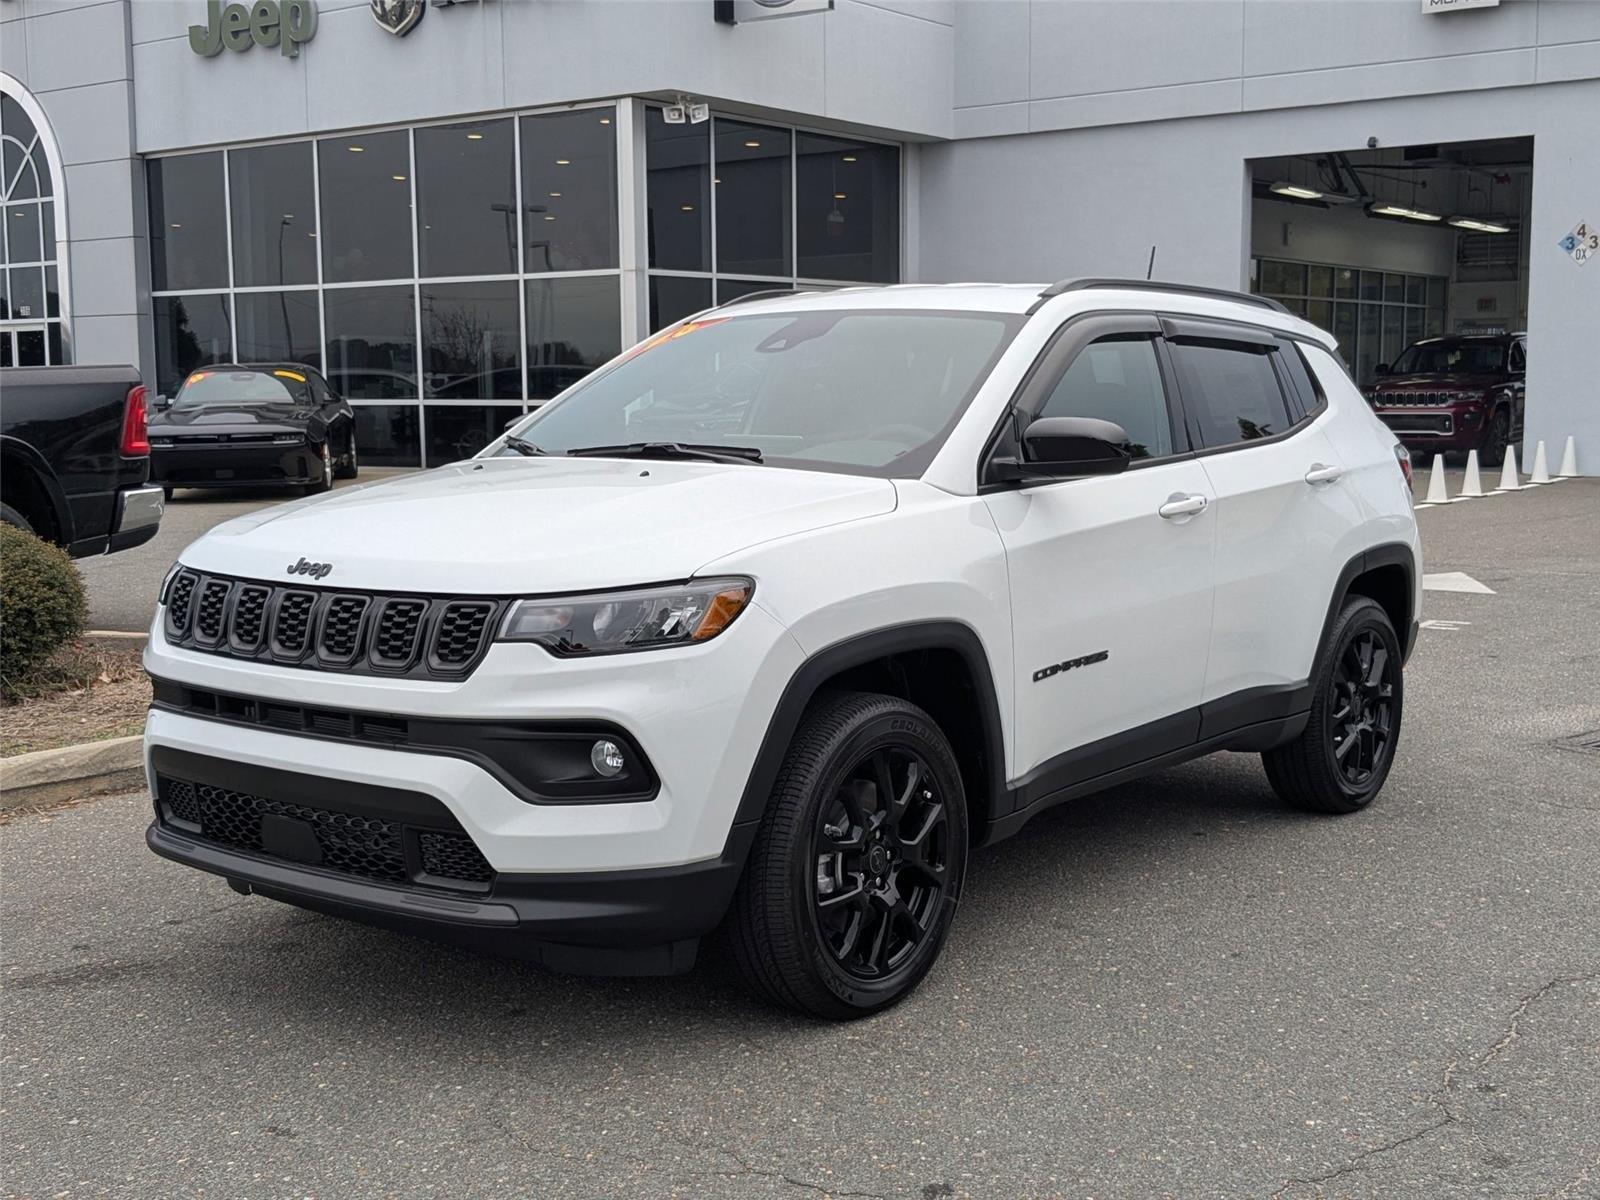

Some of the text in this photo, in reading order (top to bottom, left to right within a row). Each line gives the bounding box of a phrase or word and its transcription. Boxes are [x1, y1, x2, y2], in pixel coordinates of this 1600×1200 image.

[188, 0, 317, 58] Jeep
[1577, 224, 1586, 238] 4
[1566, 236, 1575, 250] 3
[1589, 235, 1598, 249] 3
[287, 557, 333, 580] Jeep
[1032, 650, 1109, 682] COMPASS
